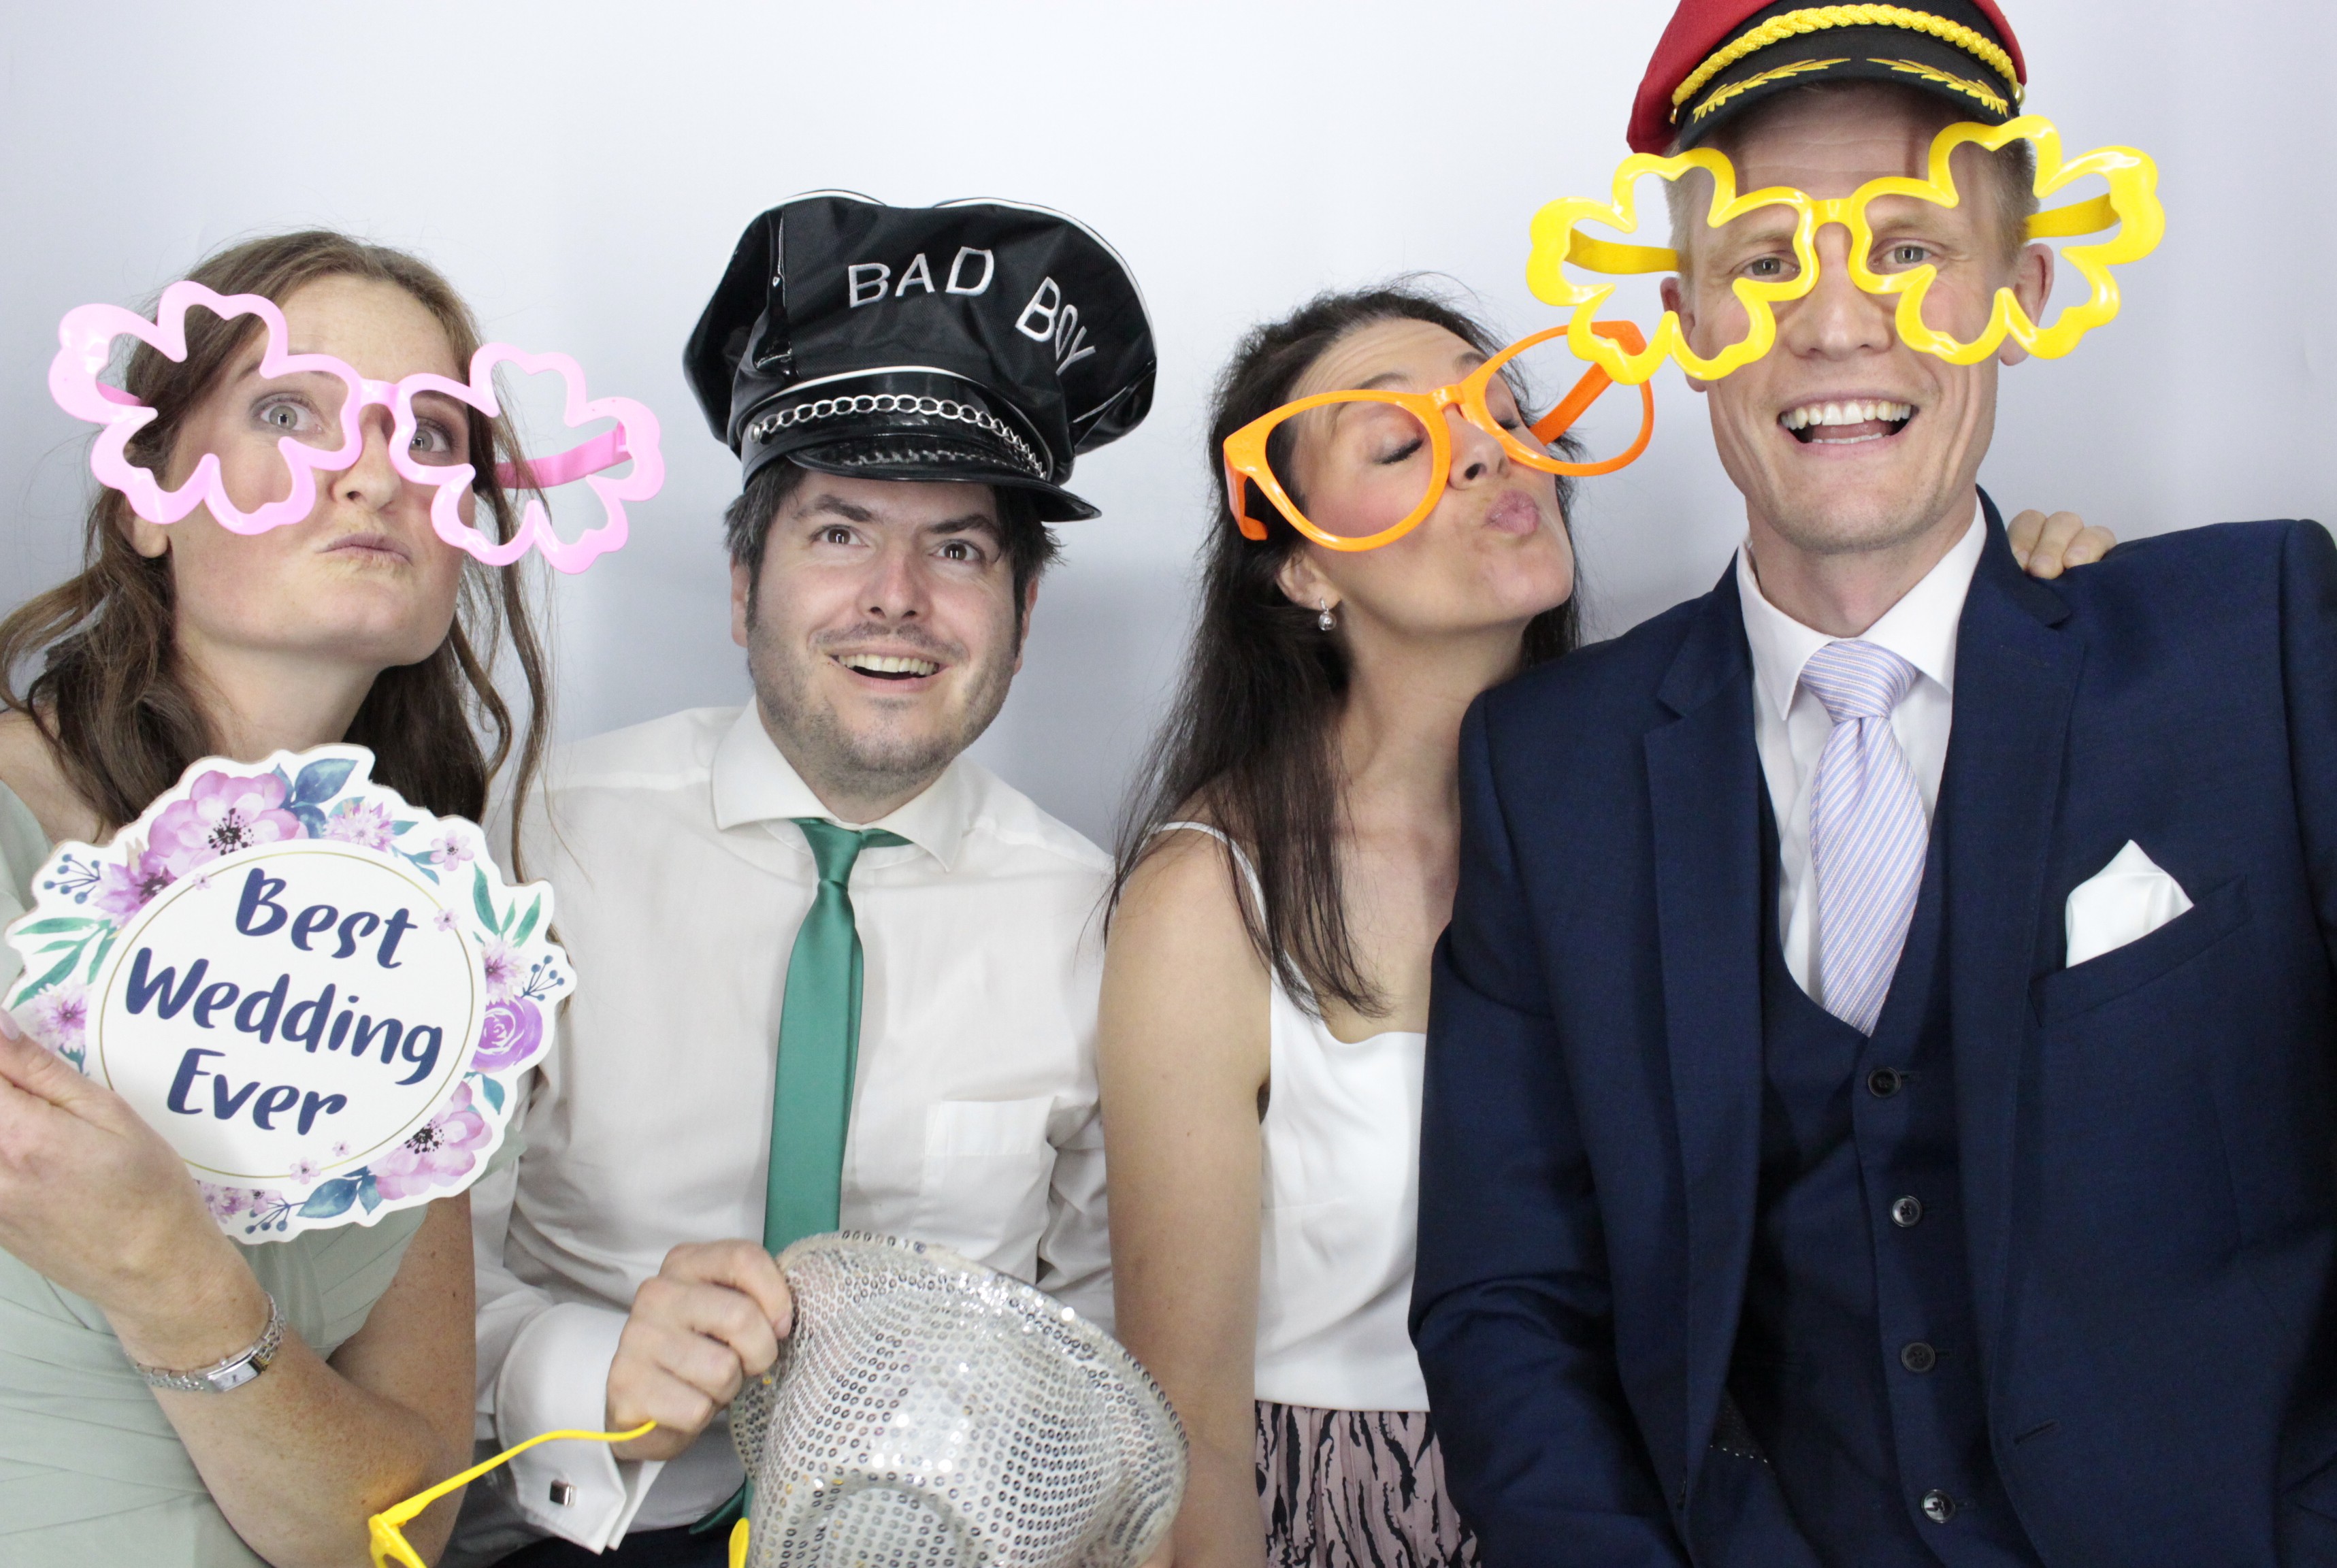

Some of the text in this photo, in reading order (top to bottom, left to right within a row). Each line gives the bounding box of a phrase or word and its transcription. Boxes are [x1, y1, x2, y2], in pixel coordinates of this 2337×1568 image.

[848, 246, 1096, 376] BAD BOY
[235, 868, 419, 969] Best
[125, 947, 443, 1086] Wedding
[167, 1047, 348, 1136] Ever
